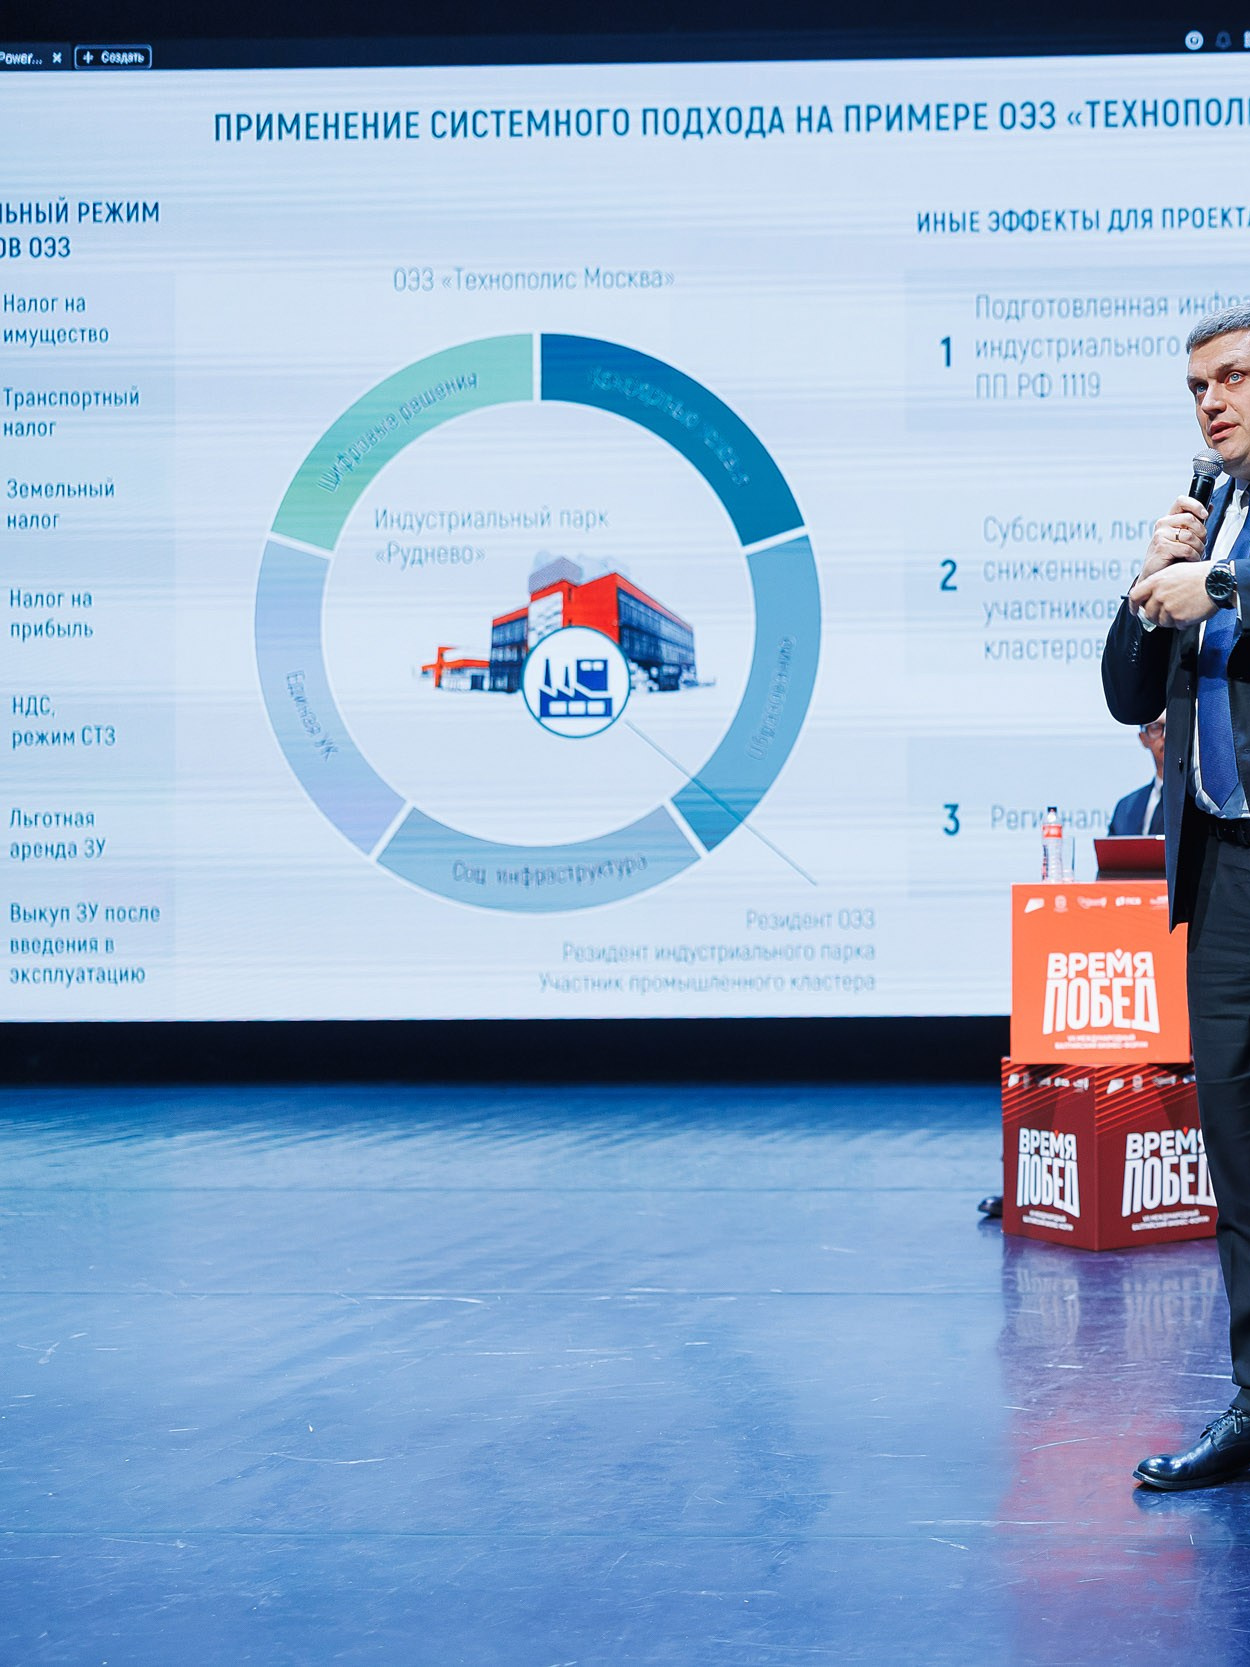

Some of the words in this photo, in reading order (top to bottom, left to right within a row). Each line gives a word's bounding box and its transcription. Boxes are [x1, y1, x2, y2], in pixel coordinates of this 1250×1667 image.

[101, 50, 145, 65] Создать
[214, 111, 420, 142] ПРИМЕНЕНИЕ
[430, 108, 631, 139] СИСТЕМНОГО
[642, 105, 785, 140] ПОДХОДА
[796, 105, 833, 134] НА
[844, 102, 989, 133] ПРИМЕРЕ
[999, 101, 1057, 130] ОЭЗ
[78, 201, 160, 223] РЕЖИМ
[917, 210, 981, 233] ИНЫЕ
[988, 208, 1100, 232] ЭФФЕКТЫ
[1107, 207, 1152, 233] ДЛЯ
[29, 236, 71, 258] ОЭЗ
[393, 266, 435, 292] ОЭЗ
[441, 266, 577, 292] «Технополис
[584, 266, 676, 290] Москва»
[3, 293, 58, 313] Налог
[65, 297, 86, 313] на
[976, 293, 1168, 322] Подготовленная
[3, 327, 109, 348] имущество
[976, 335, 1181, 364] индустриального
[940, 335, 952, 368] 1
[3, 385, 140, 411] Транспортный
[976, 373, 1007, 399] ПП
[1017, 372, 1052, 398] РФ
[1062, 372, 1101, 398] 1119
[399, 372, 478, 425] решения
[3, 421, 56, 437] налог
[7, 477, 115, 499] Земельный
[7, 513, 60, 530] налог
[374, 504, 551, 535] Индустриальный
[559, 509, 609, 532] парк
[983, 515, 1104, 548] Субсидии,
[375, 540, 486, 572] «Руднево»
[940, 559, 958, 592] 2
[983, 559, 1122, 583] сниженные
[10, 588, 65, 608] Налог
[71, 592, 92, 608] на
[10, 618, 94, 642] прибыль
[12, 694, 56, 718] НДС,
[12, 731, 75, 750] режим
[81, 725, 116, 746] СТЗ
[10, 807, 95, 829] Льготная
[942, 803, 960, 836] 3
[10, 841, 77, 862] аренда
[84, 837, 106, 858] ЗУ
[496, 853, 649, 889] инфраструктура
[10, 902, 70, 927] Выкуп
[77, 902, 98, 923] ЗУ
[105, 906, 160, 922] после
[746, 909, 833, 931] Резидент
[838, 908, 875, 930] ОЭЗ
[10, 937, 98, 955] введения
[105, 937, 115, 954] в
[562, 942, 648, 963] Резидент
[655, 942, 814, 965] индустриального
[820, 944, 876, 964] парка
[1047, 949, 1155, 979] ВРЕМЯ
[9, 966, 146, 988] эксплуатацию
[539, 972, 623, 994] Участник
[628, 973, 784, 995] промышленного
[791, 973, 876, 994] кластера
[1042, 977, 1161, 1035] ПОБЕД
[1018, 1127, 1078, 1160] ВРЕМЯ
[1016, 1154, 1081, 1218] ПОБЕД
